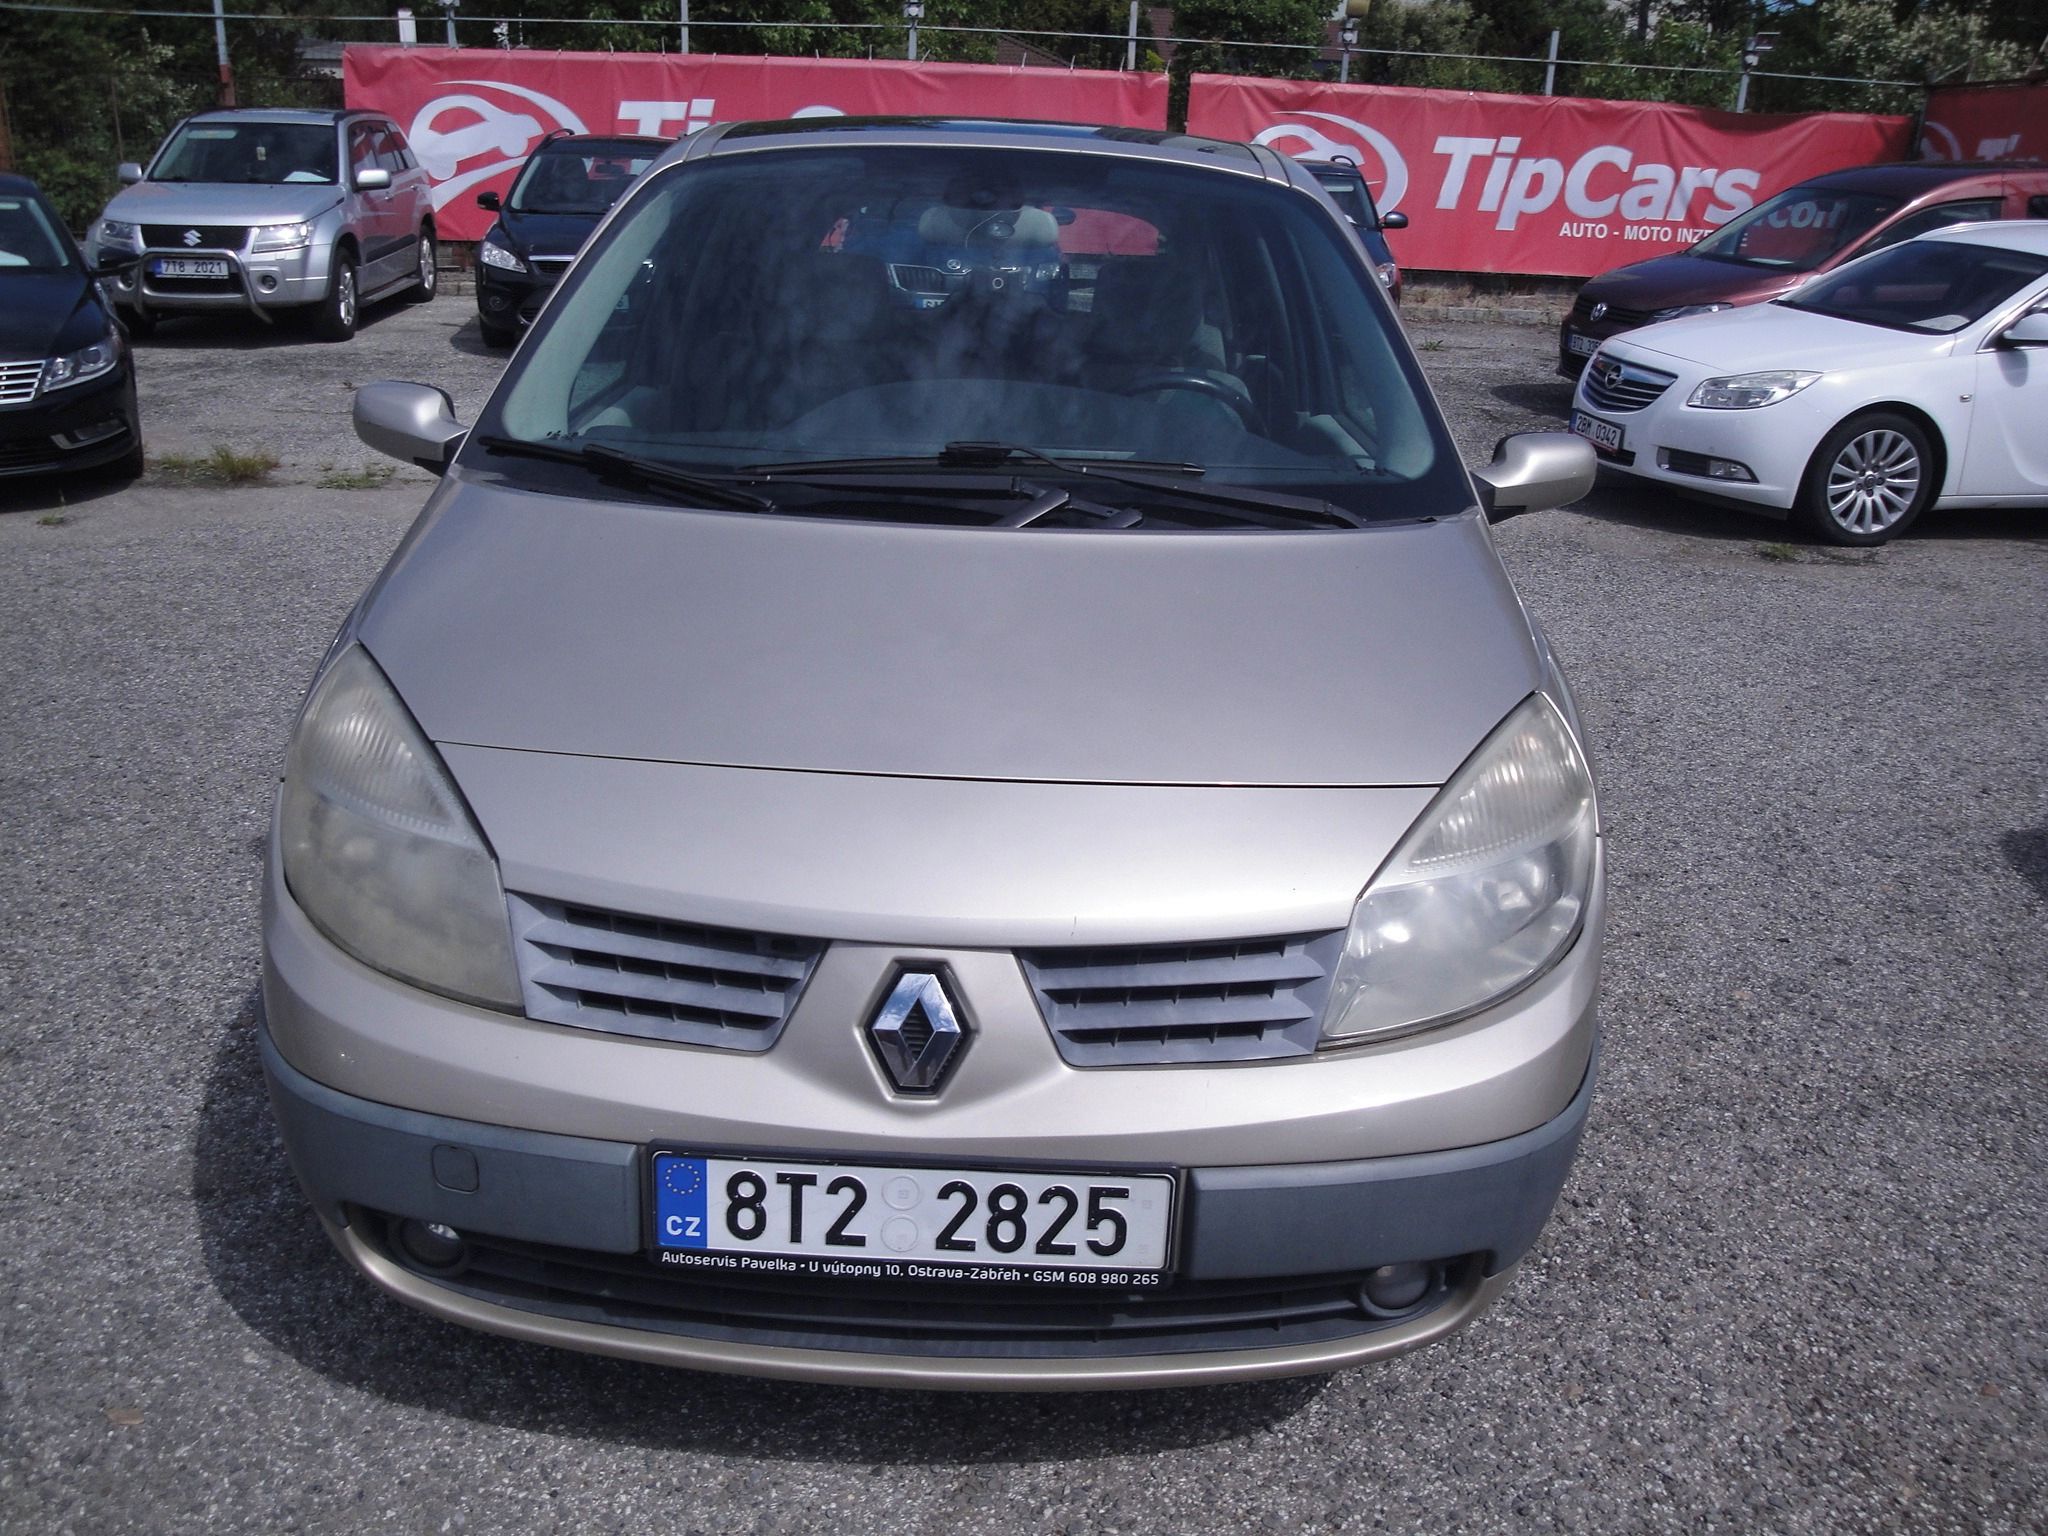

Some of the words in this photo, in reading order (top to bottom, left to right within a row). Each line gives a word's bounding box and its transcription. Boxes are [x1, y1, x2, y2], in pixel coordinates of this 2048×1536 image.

[1559, 222, 1608, 239] AUTO
[1624, 225, 1672, 242] MOTO
[163, 260, 185, 273] 7T8
[194, 261, 223, 274] 2021
[1595, 423, 1617, 446] 0342
[725, 1170, 868, 1247] 8T2
[934, 1179, 1131, 1257] 2825
[665, 1216, 701, 1237] CZ
[661, 1251, 737, 1268] Autoservis
[741, 1257, 797, 1271] Pavelka
[808, 1261, 819, 1272] U
[822, 1260, 882, 1277] výtopny
[1033, 1271, 1065, 1283] GSM
[1068, 1272, 1097, 1284] 608
[1101, 1273, 1129, 1284] 980
[1132, 1273, 1159, 1285] 265
